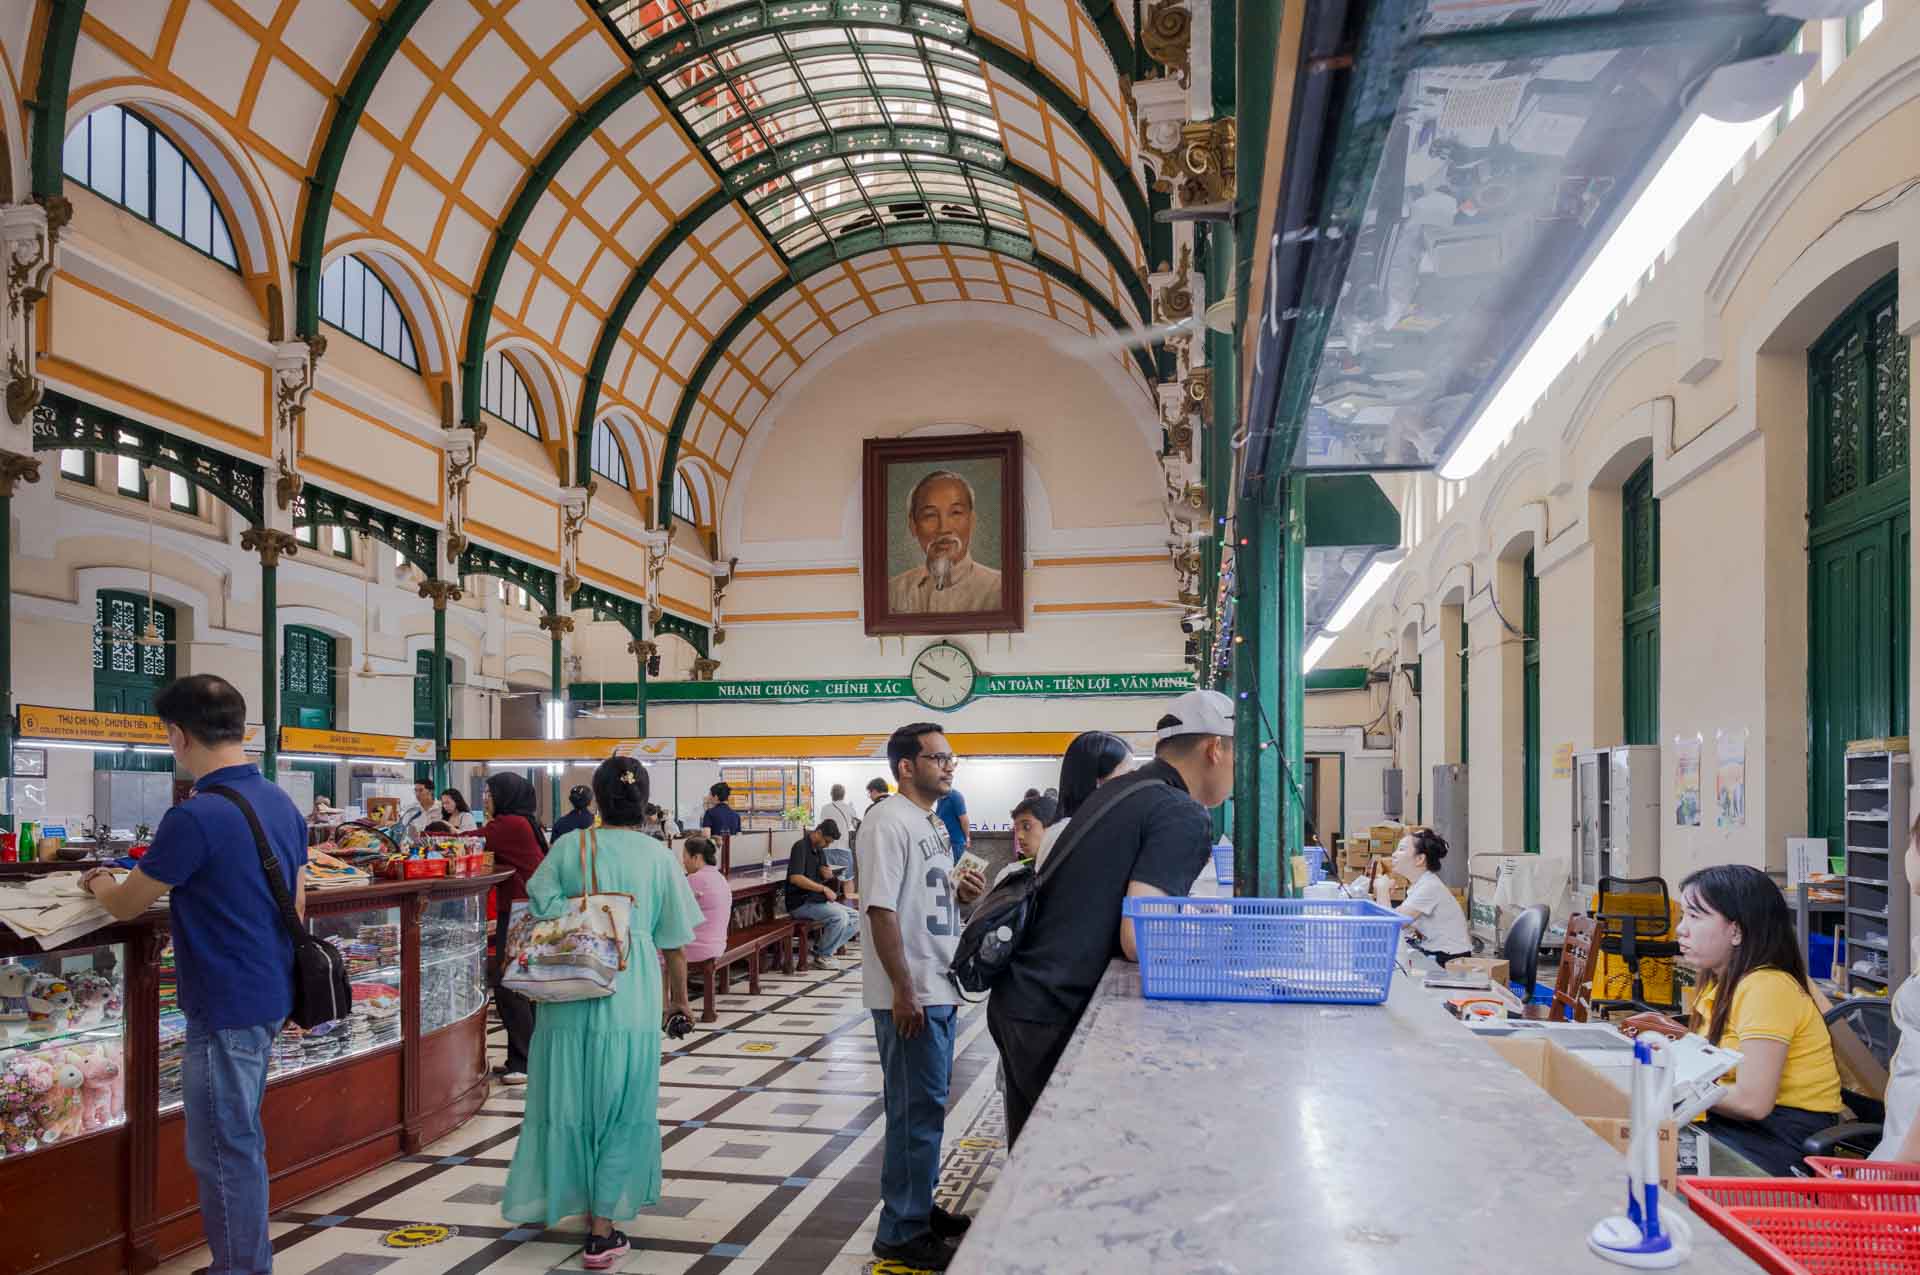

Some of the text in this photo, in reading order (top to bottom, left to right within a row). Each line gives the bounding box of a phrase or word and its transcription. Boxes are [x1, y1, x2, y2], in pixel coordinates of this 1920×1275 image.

[718, 685, 761, 697] NHANH
[765, 682, 809, 696] CHÓNG
[825, 682, 868, 695] CHÍNH
[874, 680, 902, 694] XÁC
[989, 680, 1006, 691] AN
[1008, 678, 1044, 691] TOÀN
[1053, 676, 1084, 692] TIỆN
[1121, 676, 1148, 690] VĂN
